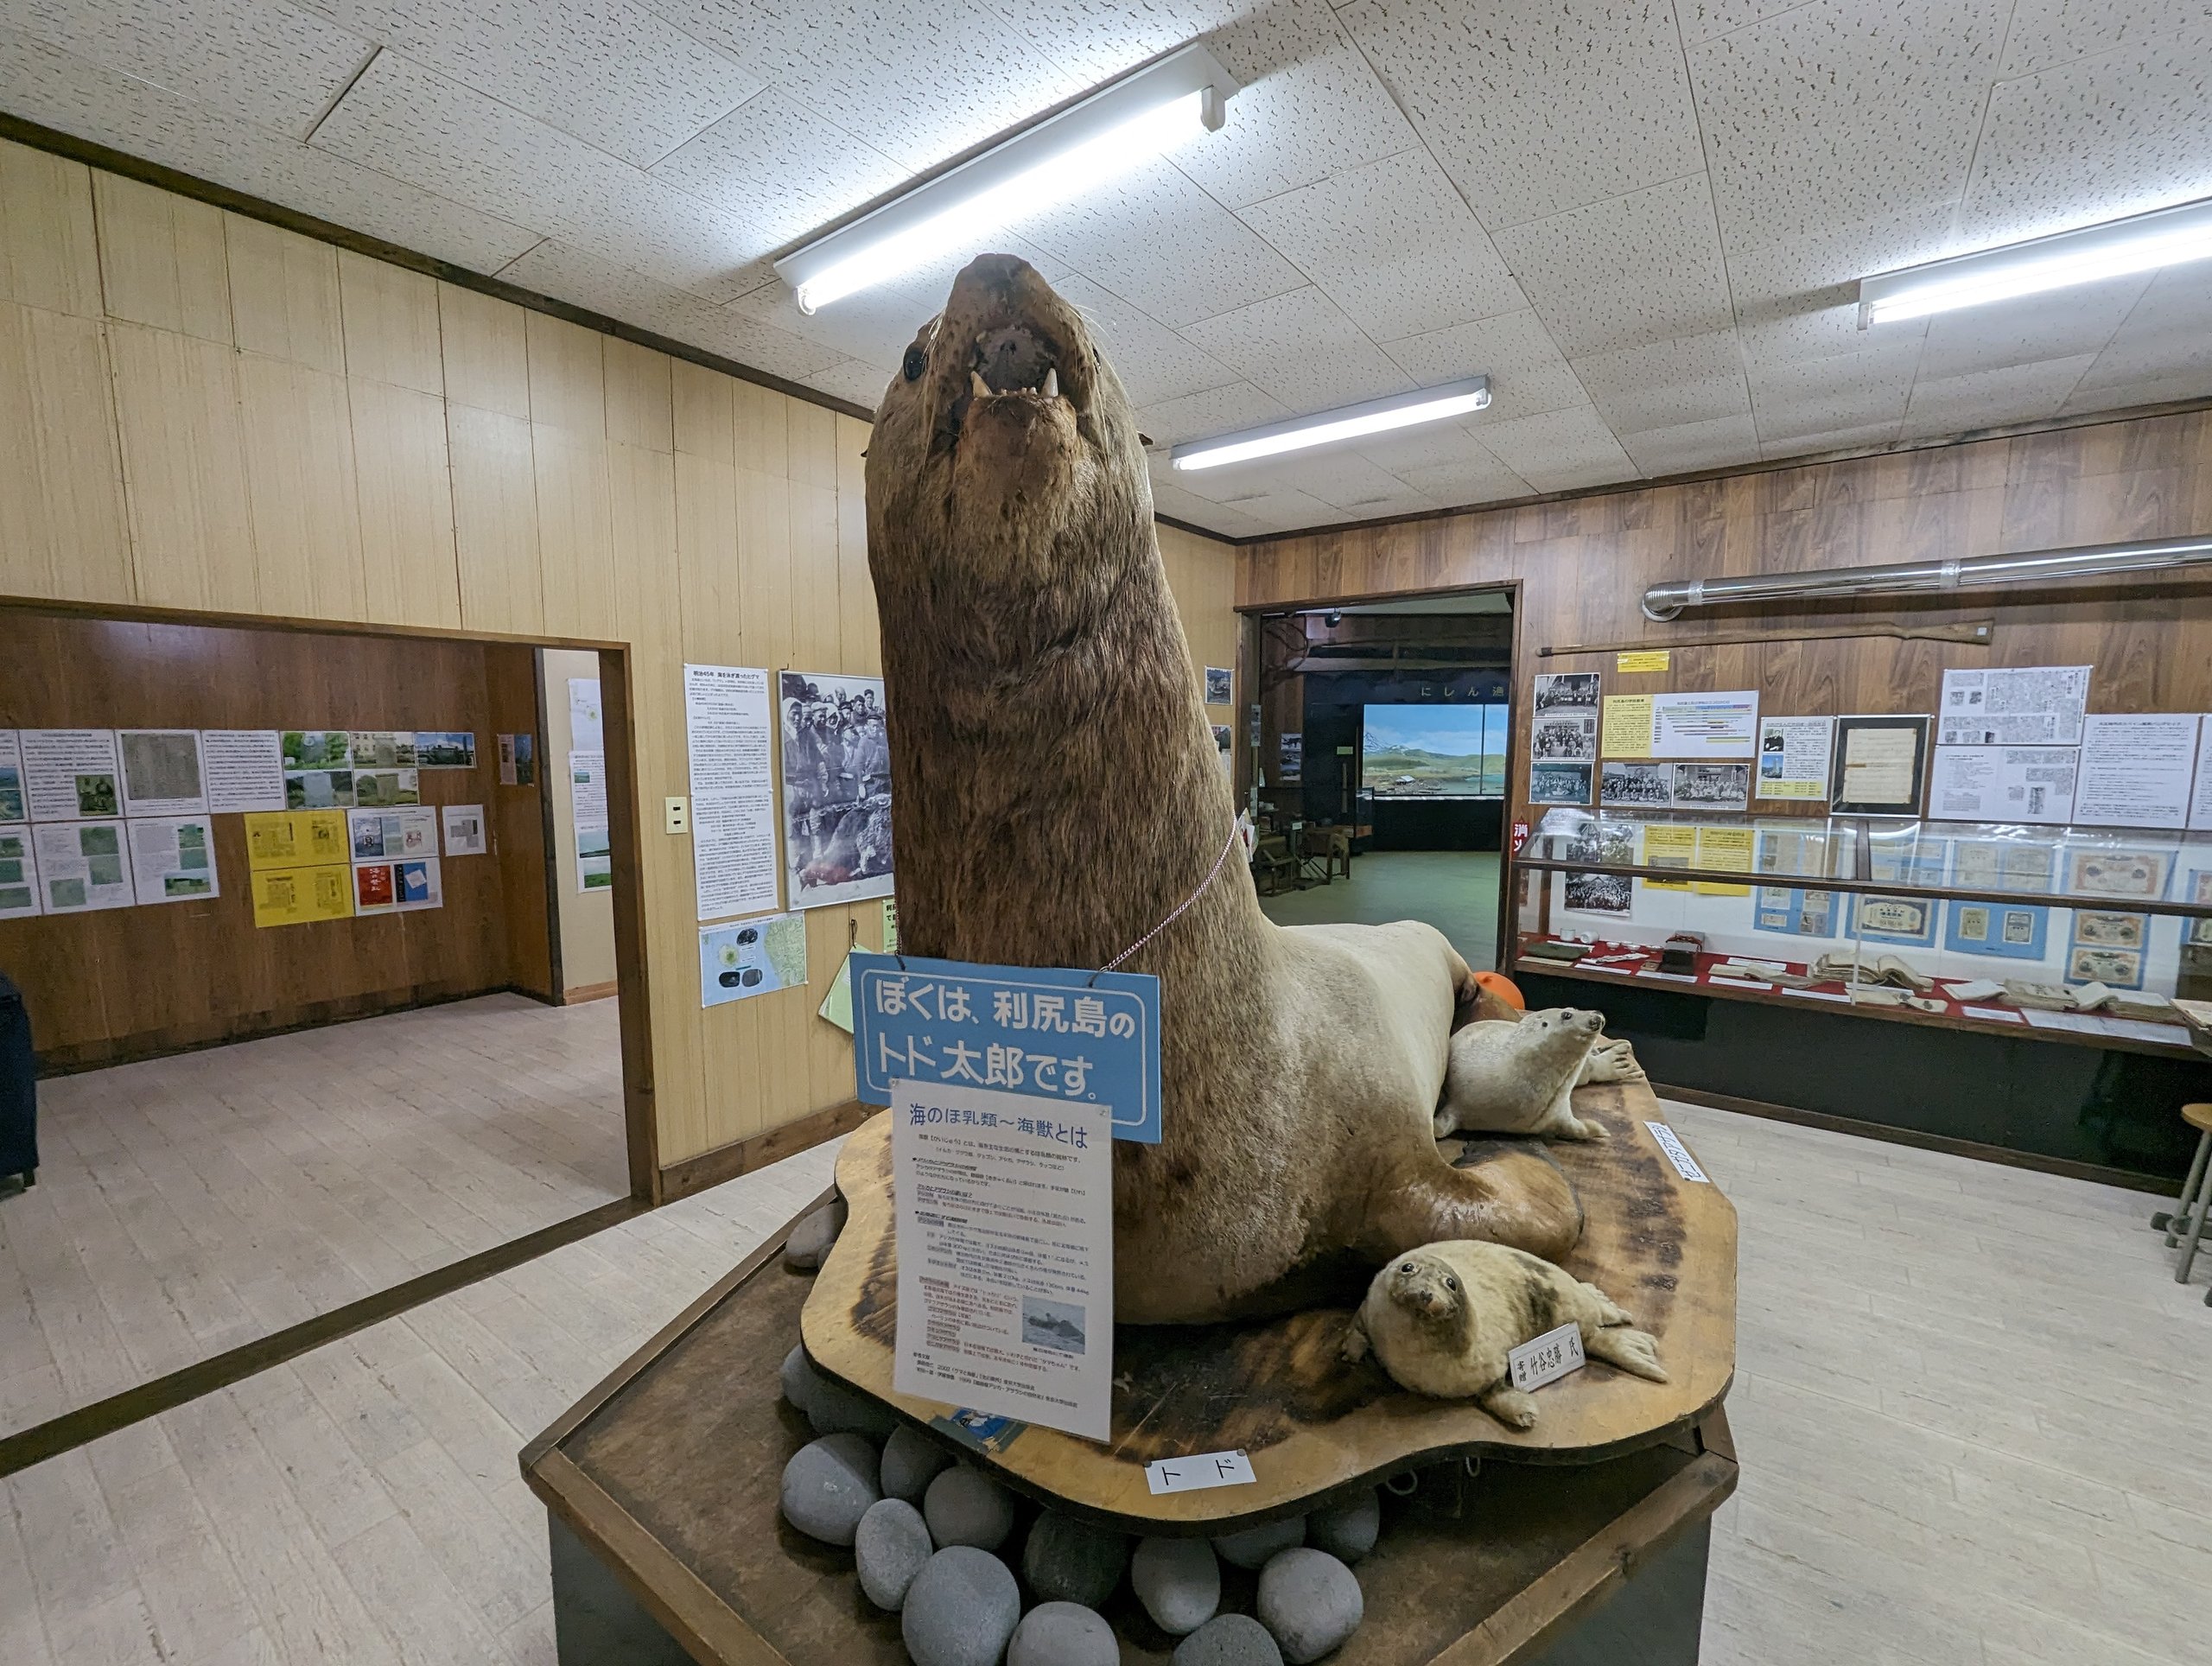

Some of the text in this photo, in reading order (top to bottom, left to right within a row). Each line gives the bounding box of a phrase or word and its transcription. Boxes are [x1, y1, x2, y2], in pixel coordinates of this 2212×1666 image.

[875, 976, 1136, 1040] ぼくは、利尻島の
[878, 1031, 1097, 1101] トド太郎です。
[1161, 1458, 1236, 1486] トド
